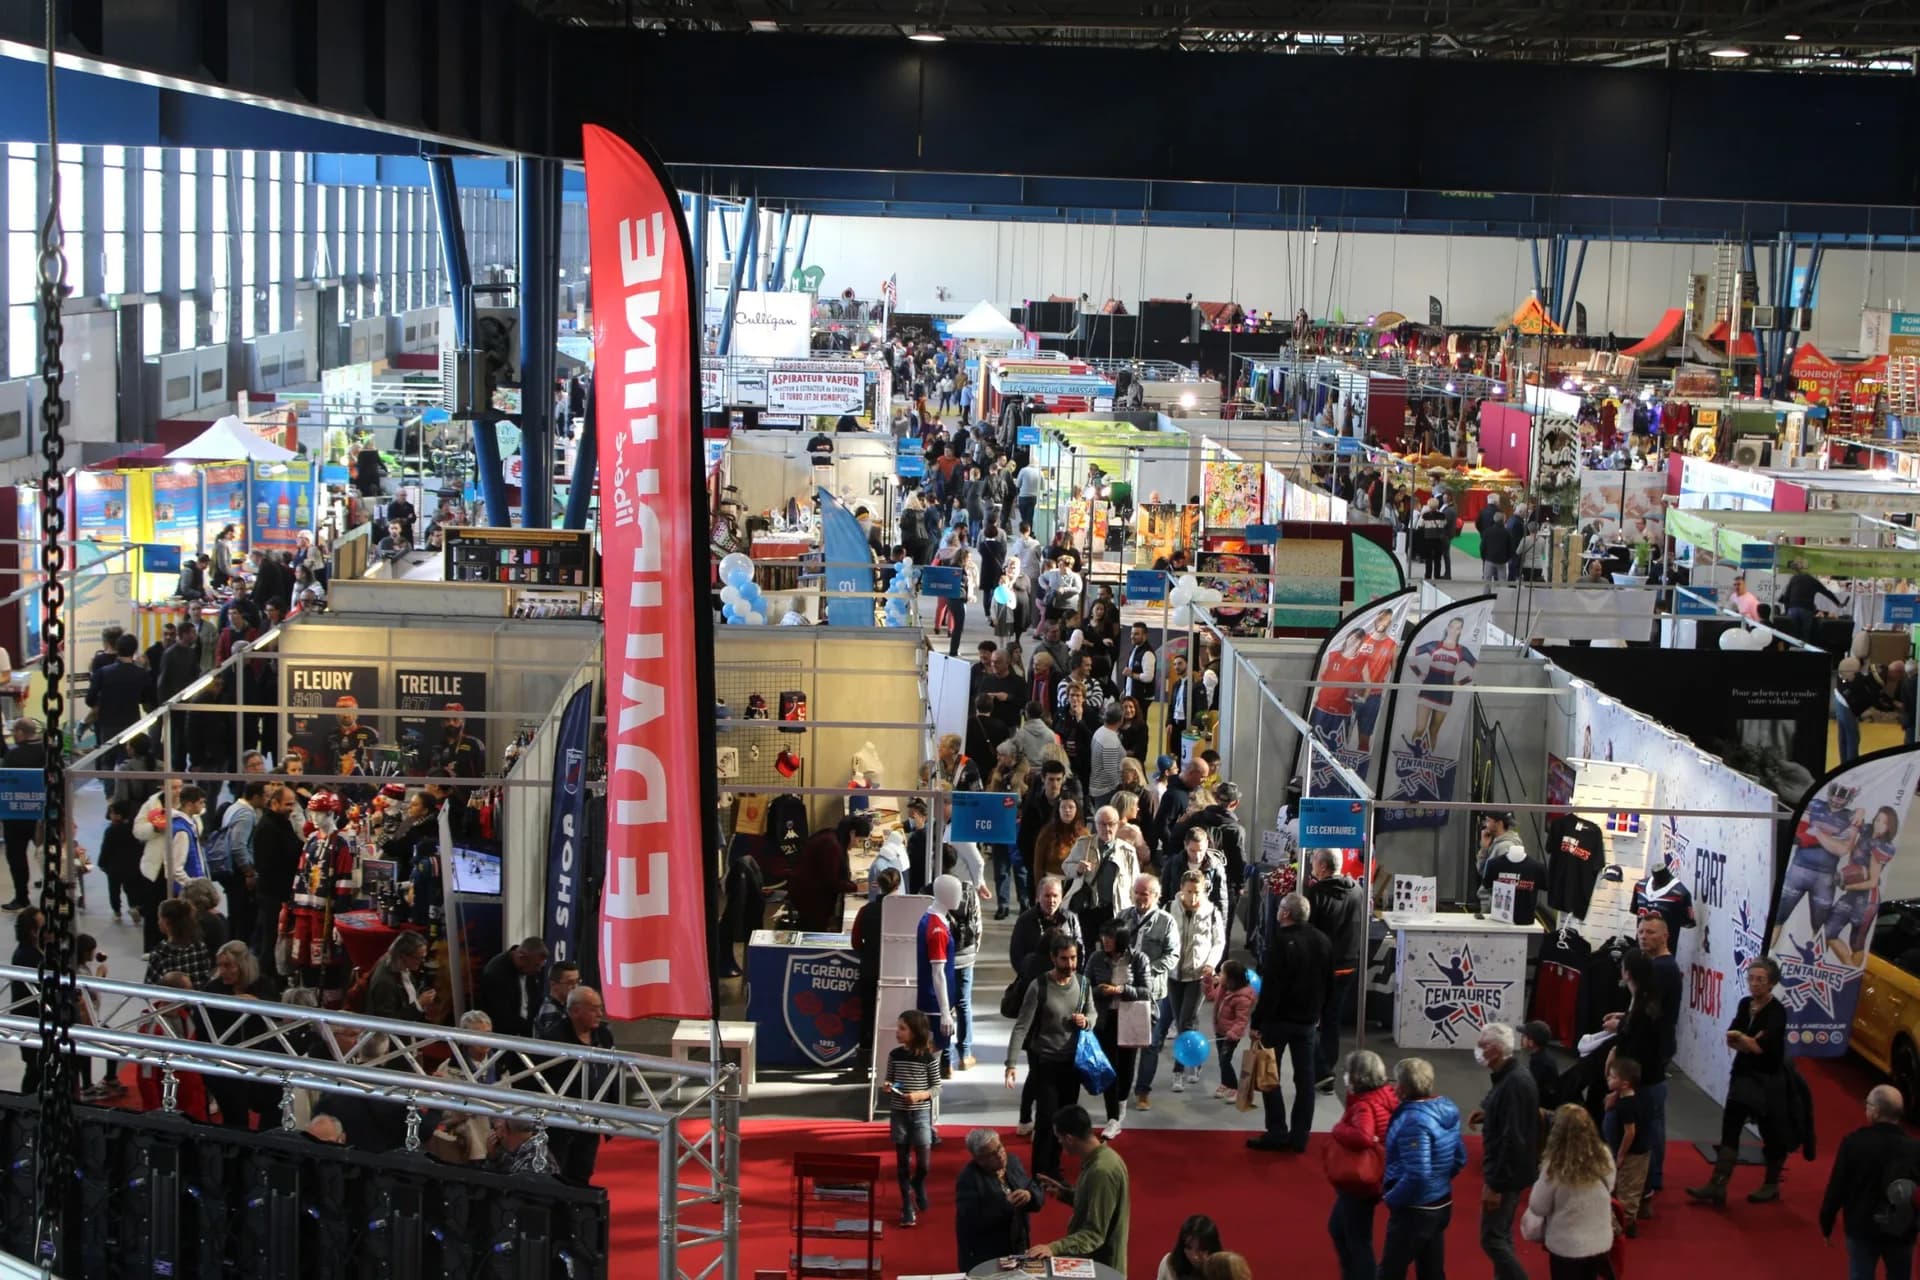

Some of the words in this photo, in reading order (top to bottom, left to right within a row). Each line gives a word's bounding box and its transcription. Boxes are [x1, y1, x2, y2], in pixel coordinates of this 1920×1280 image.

[735, 311, 797, 331] Culligan
[772, 374, 823, 386] ASPIRATEUR
[826, 375, 859, 388] VAPEUR
[293, 670, 353, 691] FLEURY
[400, 674, 462, 695] TREILLE
[1732, 688, 1750, 697] Pour
[1751, 688, 1780, 697] acheter
[1781, 689, 1789, 697] et
[1395, 757, 1447, 777] CENTAURES
[0, 792, 13, 801] LES
[9, 802, 18, 811] DE
[20, 802, 42, 811] LOUPS
[975, 819, 992, 830] FCG
[1306, 825, 1318, 834] LES
[1319, 826, 1357, 836] CENTAURES
[555, 813, 575, 929] SHOP
[1693, 848, 1727, 908] FORT
[1703, 925, 1711, 954] &
[793, 962, 810, 975] FC
[811, 964, 861, 980] GRENOB
[1780, 962, 1845, 991] CENTAURES
[812, 977, 855, 992] RUGBY
[1689, 962, 1724, 1019] DROIT
[1424, 988, 1502, 1010] CENTAURES
